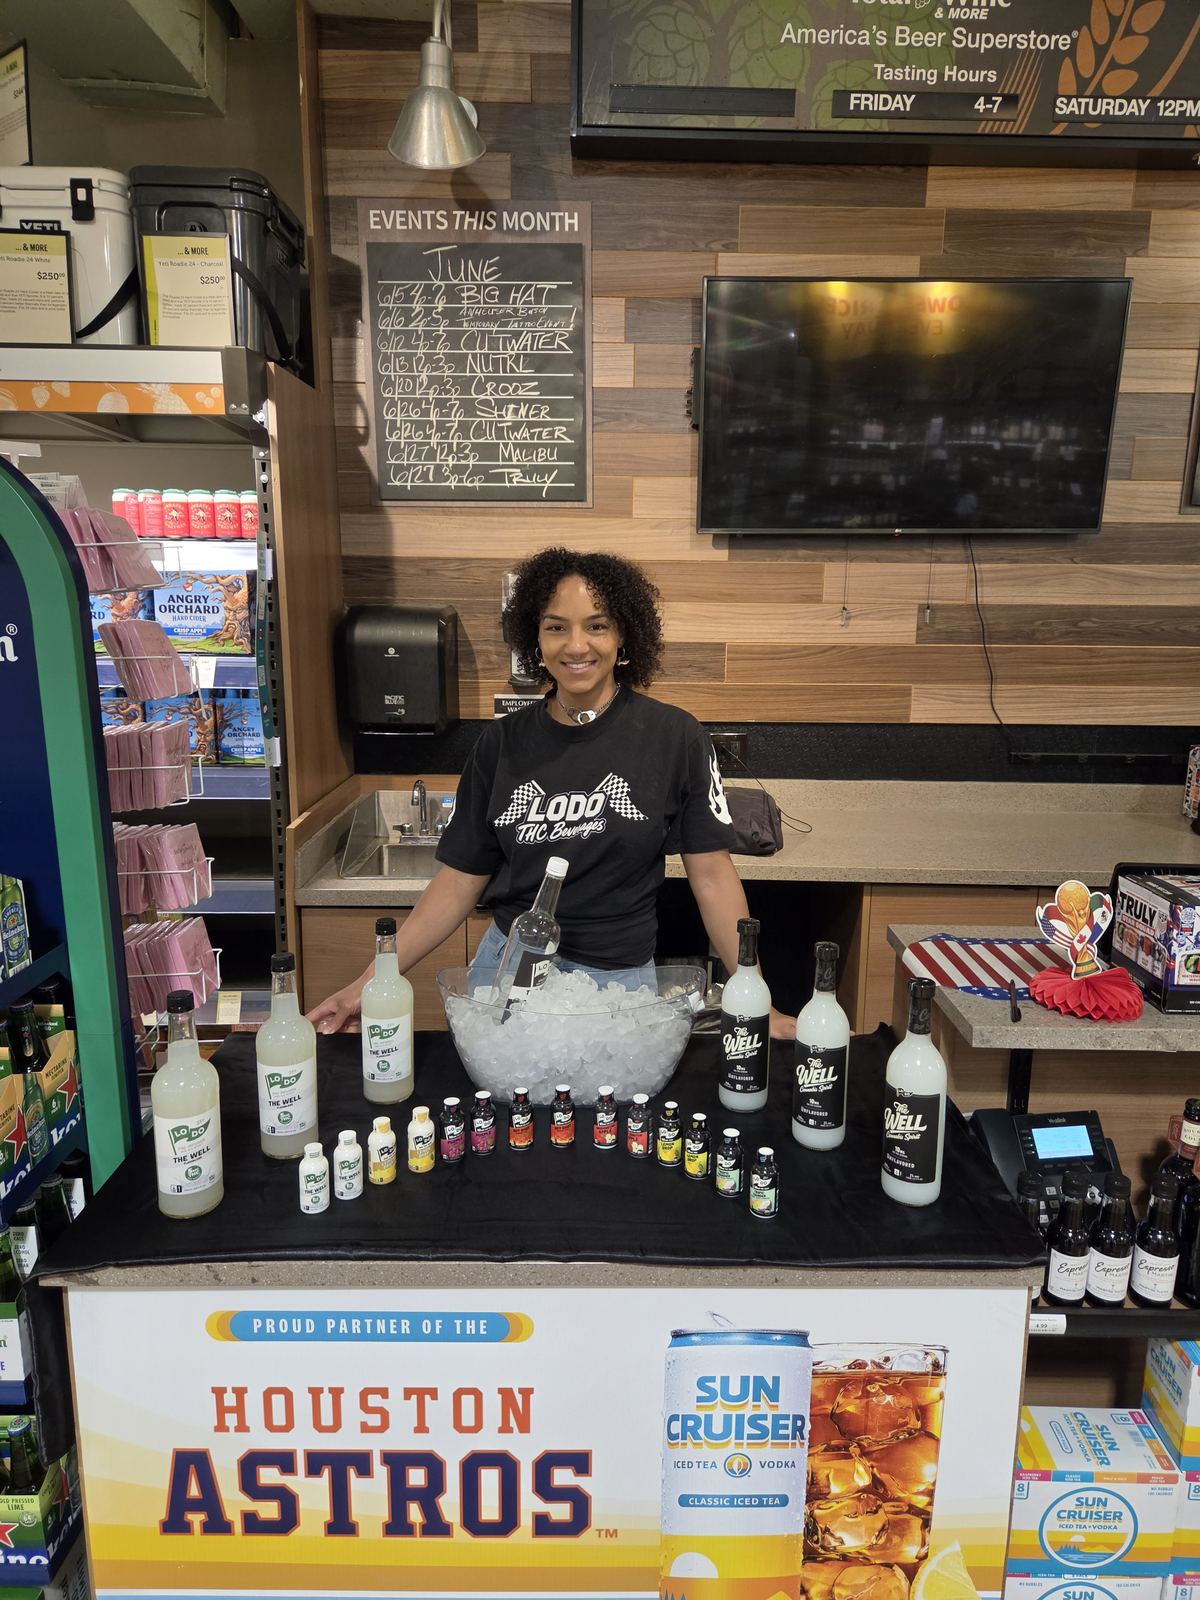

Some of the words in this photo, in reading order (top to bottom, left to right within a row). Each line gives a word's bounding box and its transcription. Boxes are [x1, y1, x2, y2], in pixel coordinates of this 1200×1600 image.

[934, 8, 944, 19] &
[948, 8, 990, 20] MORE
[780, 22, 889, 47] America's
[895, 25, 946, 48] Beer
[874, 64, 938, 85] Tasting
[944, 66, 998, 83] Hours
[849, 94, 916, 114] FRIDAY
[974, 95, 1003, 114] 4-7
[1055, 97, 1150, 117] SATURDAY
[369, 210, 449, 230] EVENTS
[453, 210, 497, 231] THIS
[502, 211, 579, 232] MONTH
[30, 243, 48, 253] MORE
[191, 247, 208, 256] MORE
[422, 245, 502, 283] JUNE
[455, 284, 500, 305] BIG
[509, 284, 558, 306] HAT
[461, 330, 573, 354] CUTWATER
[467, 353, 535, 376] NUTRL
[471, 375, 541, 399] CROOZ
[475, 397, 551, 420] SHINER
[470, 420, 572, 442] CUTWATER
[500, 442, 558, 464] MALIBU
[489, 468, 559, 498] TRULY
[159, 604, 220, 615] ORCHARD
[167, 594, 209, 605] ANGRY
[527, 792, 606, 822] LODO
[518, 824, 549, 843] THC
[550, 819, 606, 841] Beverages
[1120, 890, 1157, 928] TRULY
[734, 1026, 749, 1037] The
[381, 1046, 399, 1055] WELL
[723, 1033, 763, 1053] WELL
[807, 1057, 823, 1068] The
[796, 1064, 838, 1085] WELL
[282, 1094, 302, 1105] WELL
[893, 1101, 910, 1114] The
[884, 1107, 927, 1131] WELL
[173, 1155, 189, 1164] THE
[190, 1145, 211, 1160] WELL
[253, 1318, 316, 1334] PROUD
[327, 1318, 412, 1334] PARTNER
[422, 1319, 445, 1334] OF
[454, 1319, 489, 1335] THE
[696, 1375, 781, 1408] SUN
[211, 1386, 534, 1434] HOUSTON
[666, 1413, 806, 1448] CRUISER
[1072, 1411, 1111, 1468] CRUISER
[1095, 1424, 1120, 1452] SUN
[673, 1460, 694, 1469] ICED
[695, 1460, 718, 1469] TEA
[759, 1460, 796, 1469] VODKA
[159, 1448, 593, 1539] ASTROS
[1016, 1483, 1025, 1493] 8
[688, 1497, 731, 1506] CLASSIC
[733, 1497, 759, 1506] ICED
[761, 1497, 781, 1505] TEA
[1075, 1496, 1109, 1508] SUN
[1057, 1509, 1123, 1522] CRUISER
[1063, 1591, 1095, 1600] SUN
[1180, 1588, 1188, 1597] 8
